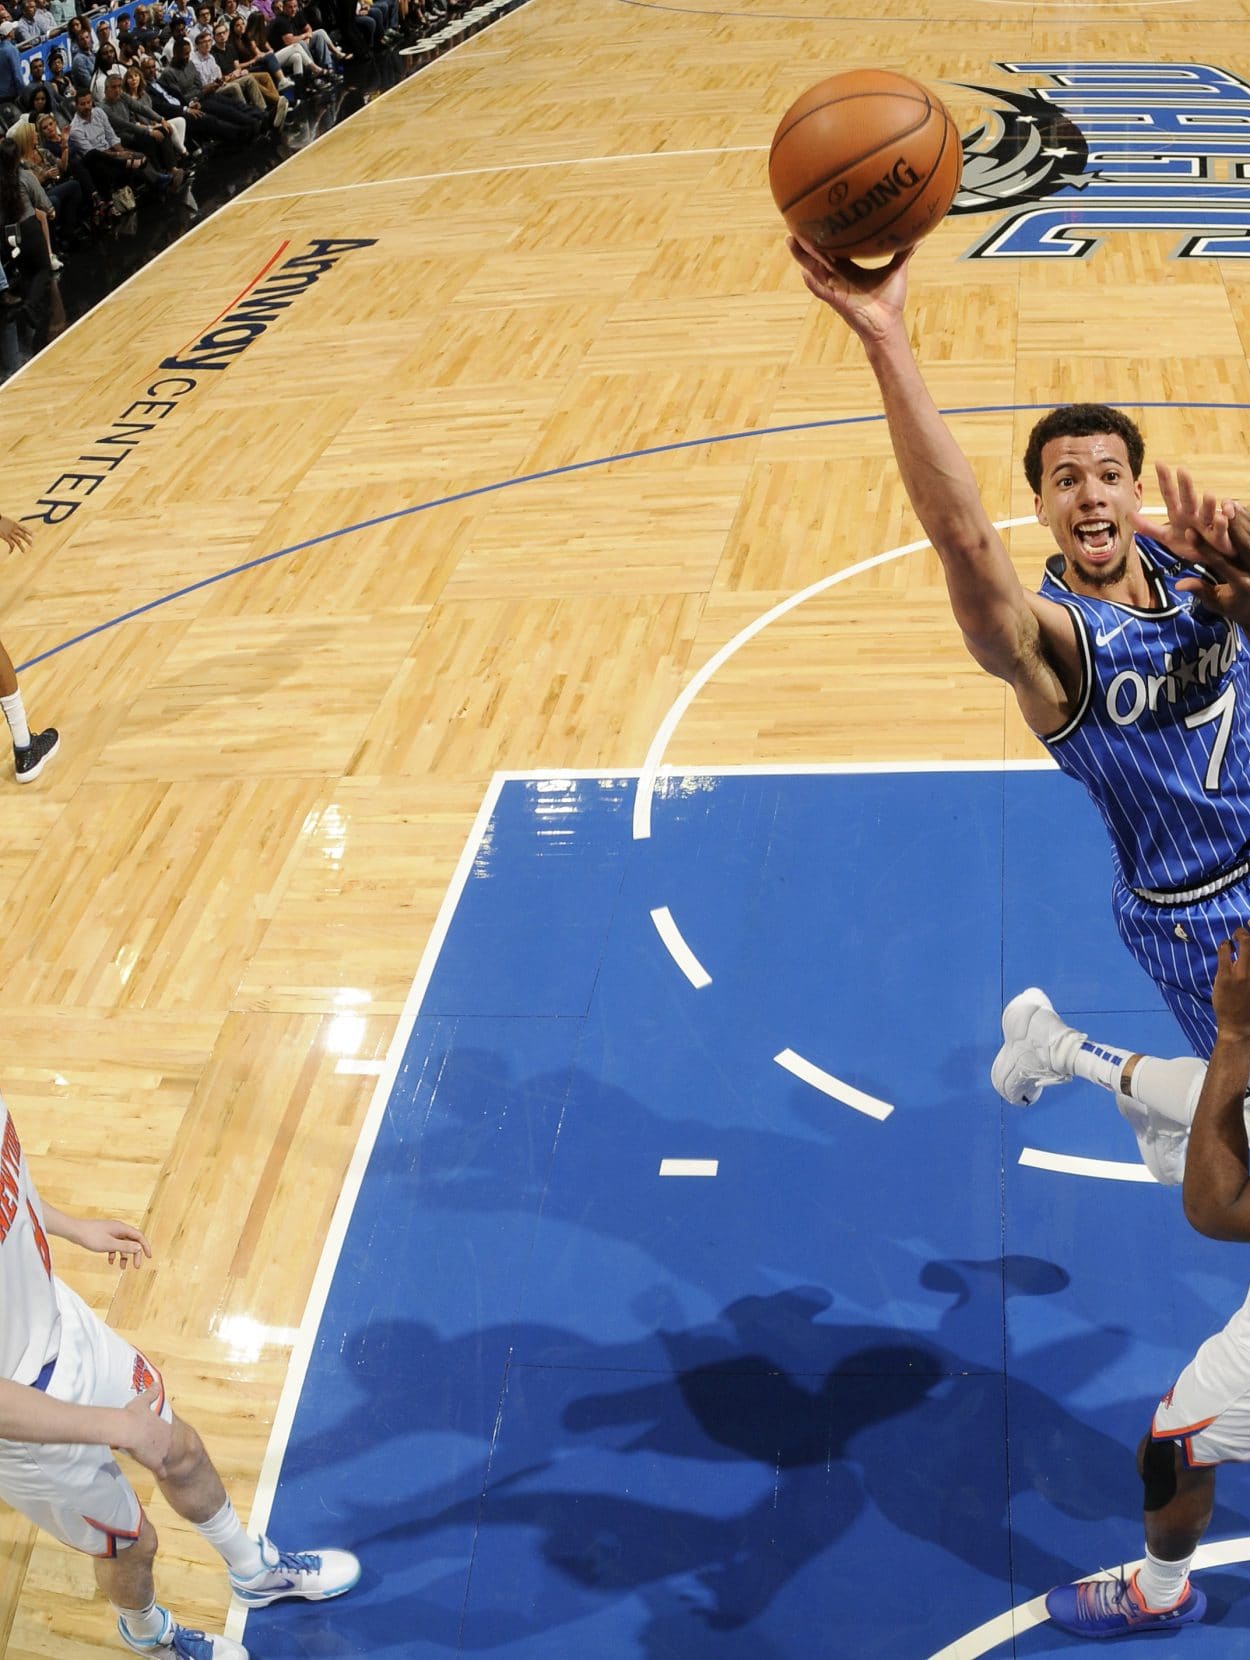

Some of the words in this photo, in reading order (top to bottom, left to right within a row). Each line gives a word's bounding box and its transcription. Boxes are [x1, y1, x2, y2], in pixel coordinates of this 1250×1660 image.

[808, 156, 923, 238] ALDING
[159, 237, 381, 371] Amway
[20, 377, 197, 525] CENTER
[1106, 622, 1242, 727] Orlnd
[1183, 681, 1237, 792] 7
